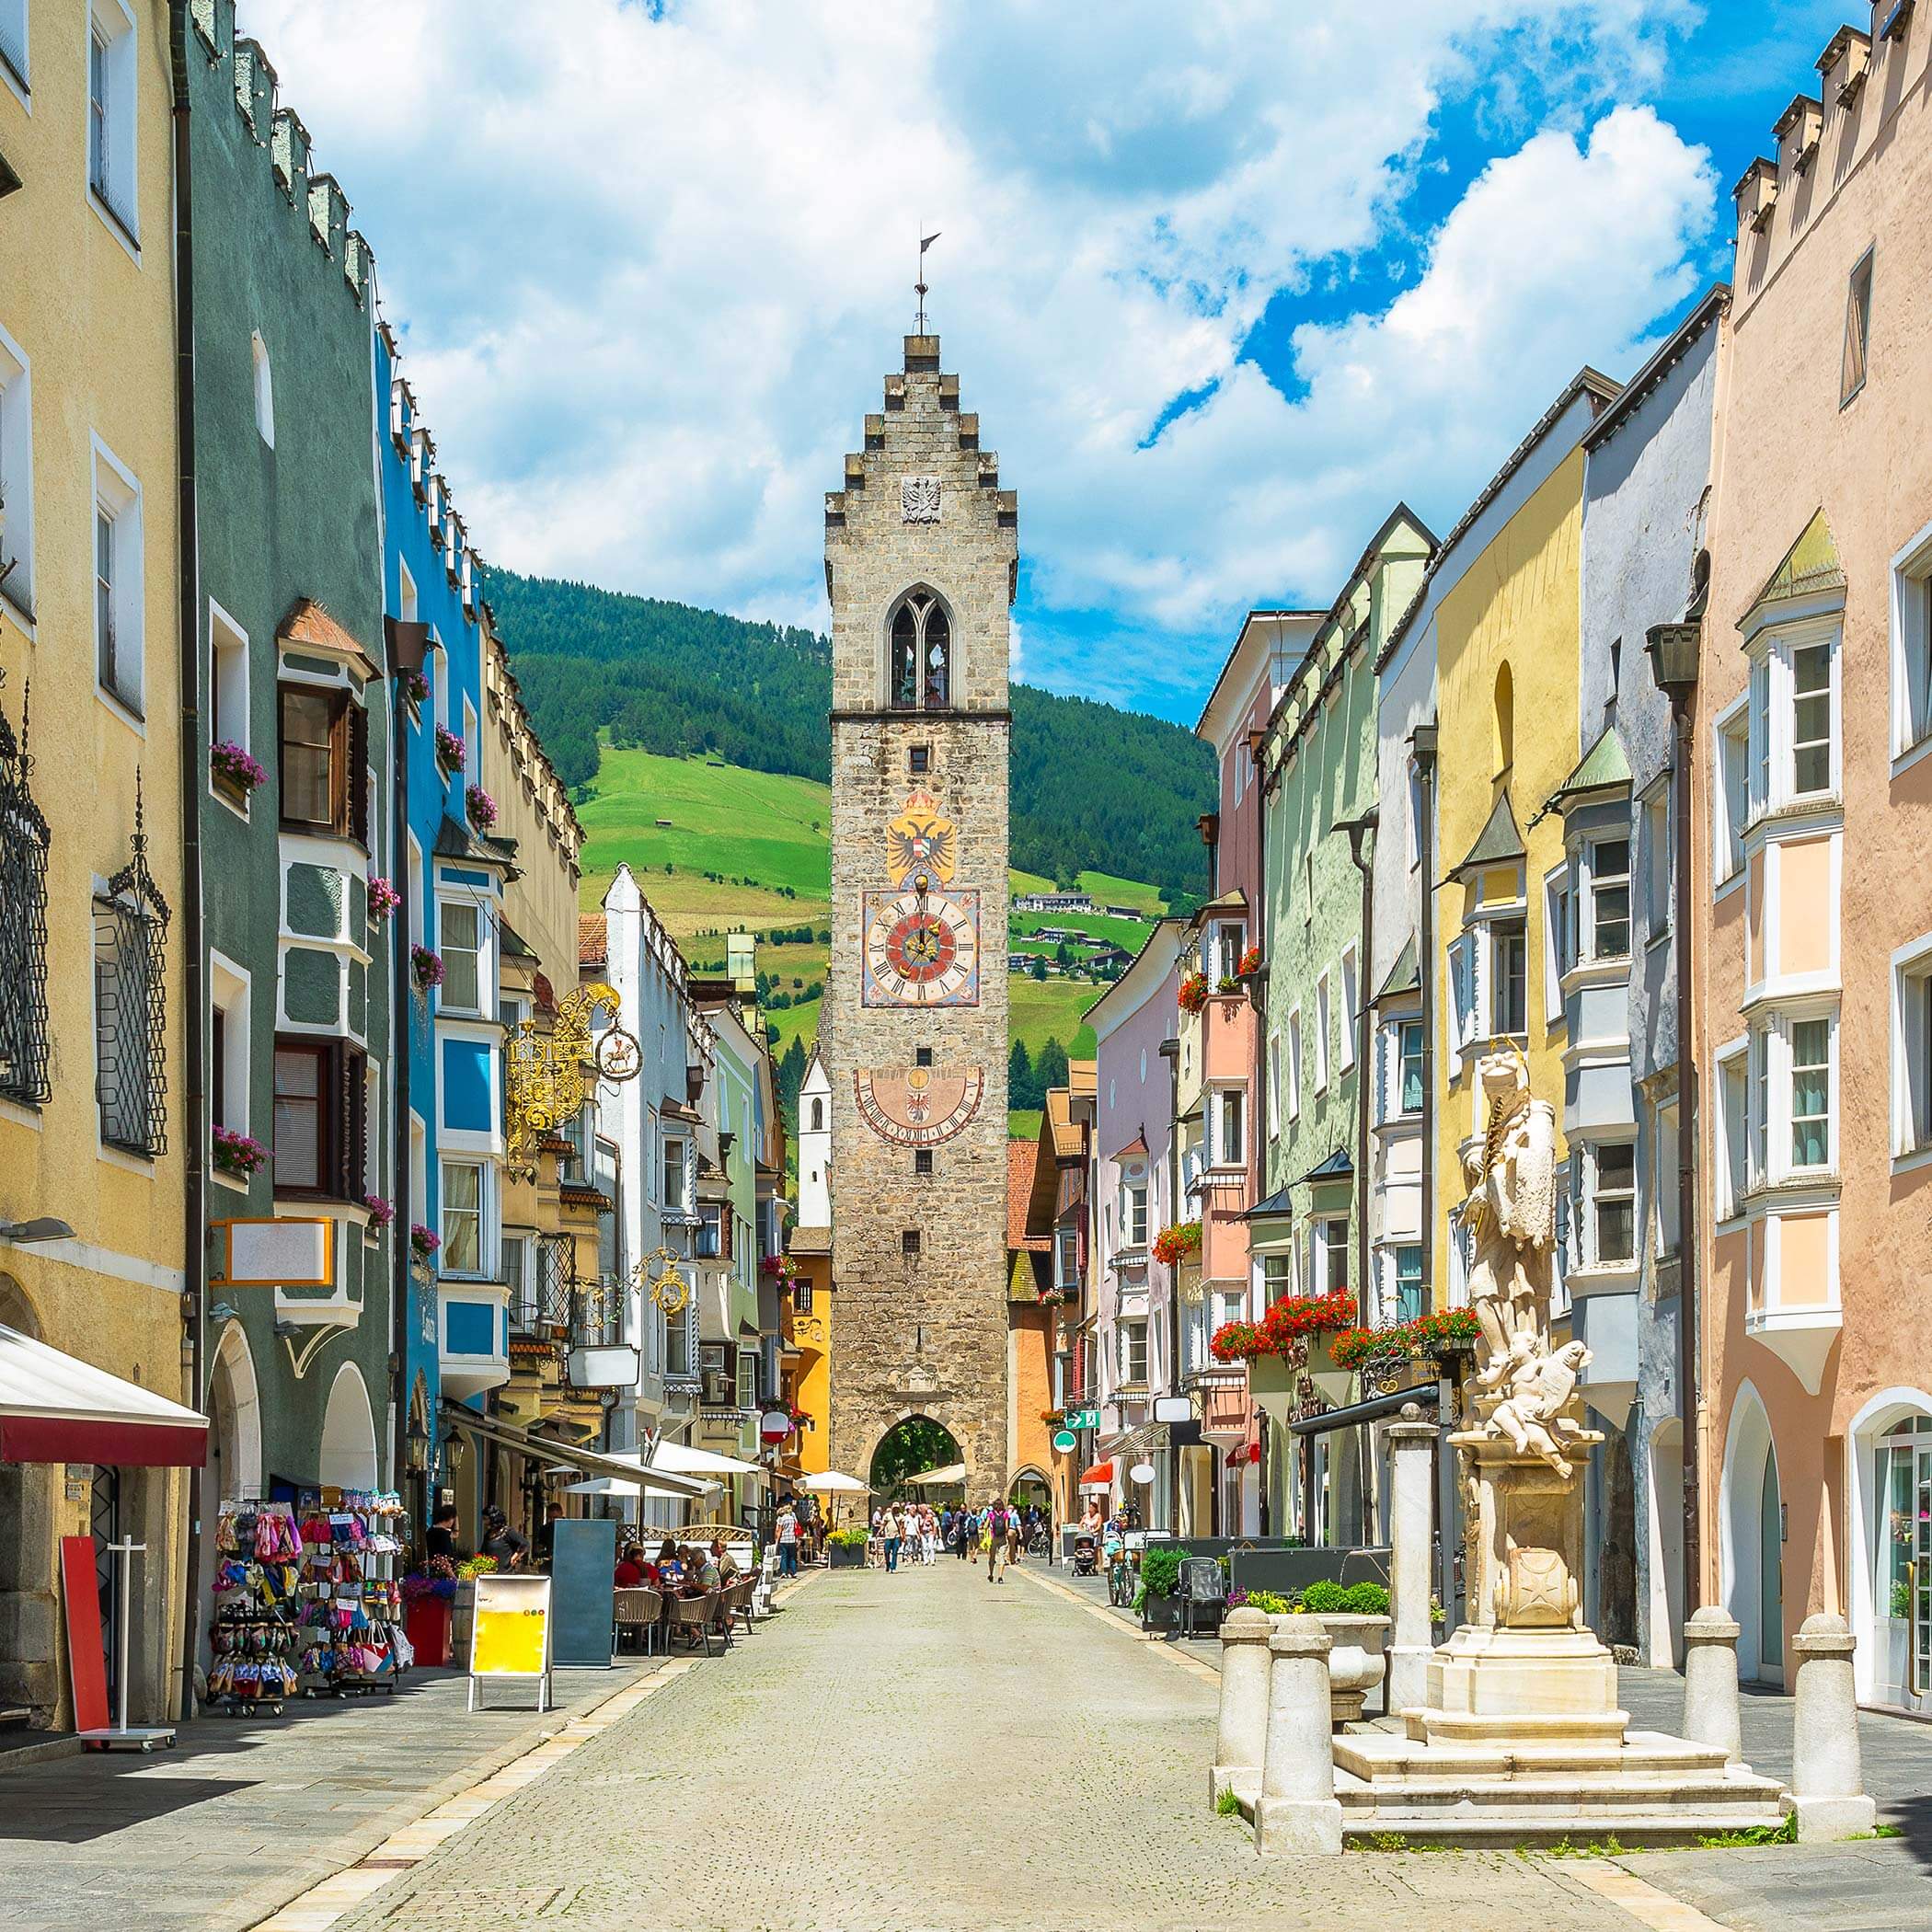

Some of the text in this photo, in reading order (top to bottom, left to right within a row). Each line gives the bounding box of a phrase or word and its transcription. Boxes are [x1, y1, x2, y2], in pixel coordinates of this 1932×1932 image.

[891, 902, 906, 918] XI
[914, 895, 928, 912] XII
[938, 902, 949, 915] I
[875, 918, 891, 933] X
[952, 918, 968, 931] II
[868, 942, 884, 952] IX
[958, 943, 973, 951] III
[873, 960, 891, 981] VIII
[916, 984, 926, 1000] VI
[939, 979, 950, 994] V
